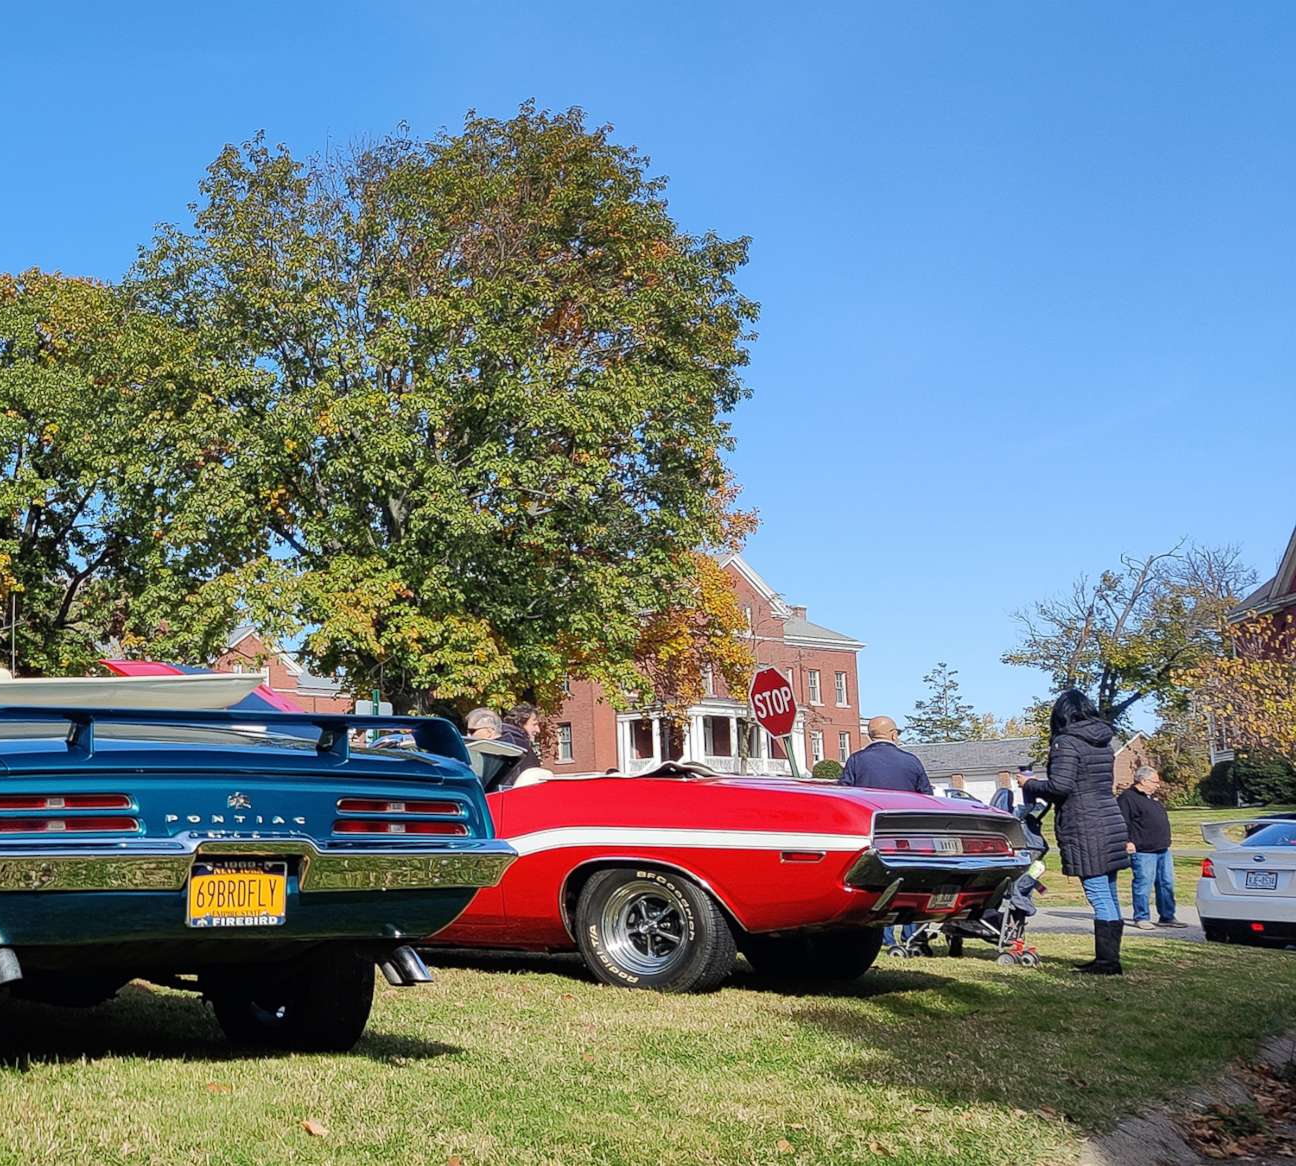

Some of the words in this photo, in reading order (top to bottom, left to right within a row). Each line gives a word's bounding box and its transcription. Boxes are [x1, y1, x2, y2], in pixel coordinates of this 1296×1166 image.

[754, 686, 791, 719] STOP
[165, 814, 306, 825] PONTIAC
[196, 879, 277, 908] 69BRDFLY
[636, 870, 696, 941] BFGoodrich
[212, 916, 278, 926] FIREBIRD
[589, 924, 599, 947] T/A
[596, 951, 640, 984] Radial
